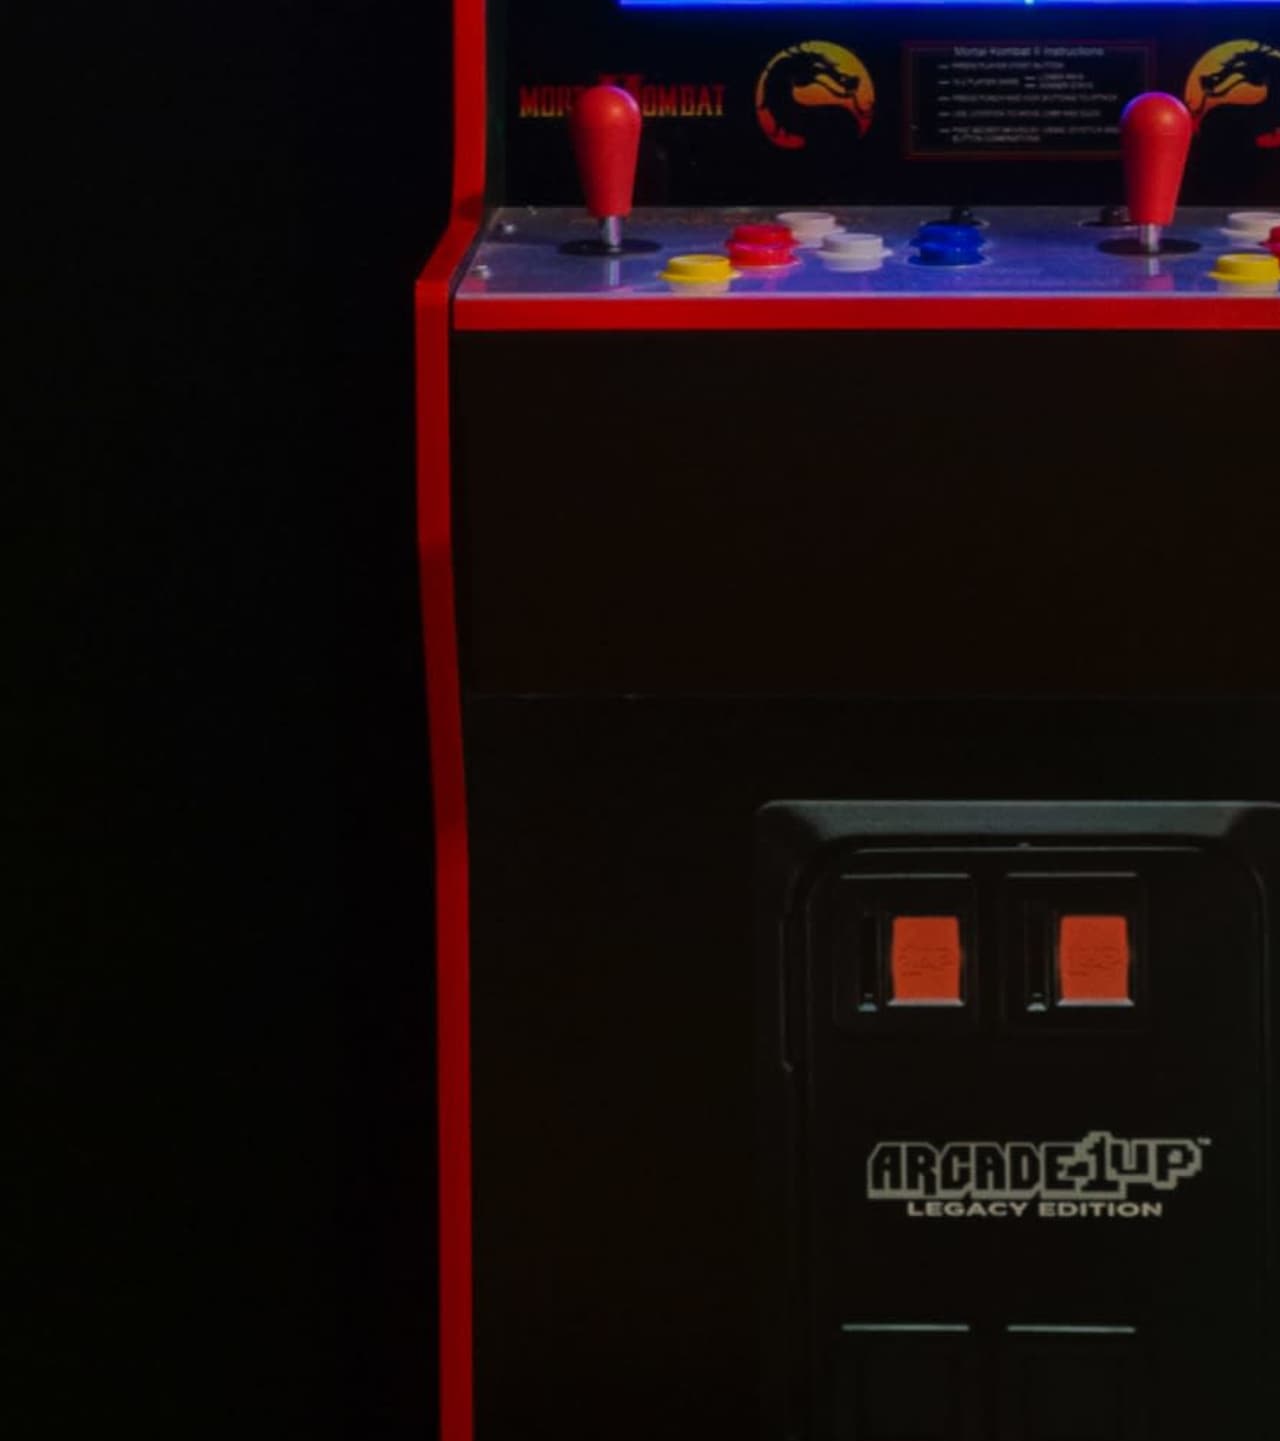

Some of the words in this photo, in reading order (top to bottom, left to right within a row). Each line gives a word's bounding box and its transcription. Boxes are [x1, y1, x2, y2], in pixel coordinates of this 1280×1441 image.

[639, 83, 725, 117] OMBAT
[906, 1201, 1028, 1217] LEGACY
[1038, 1201, 1163, 1217] EDITION
